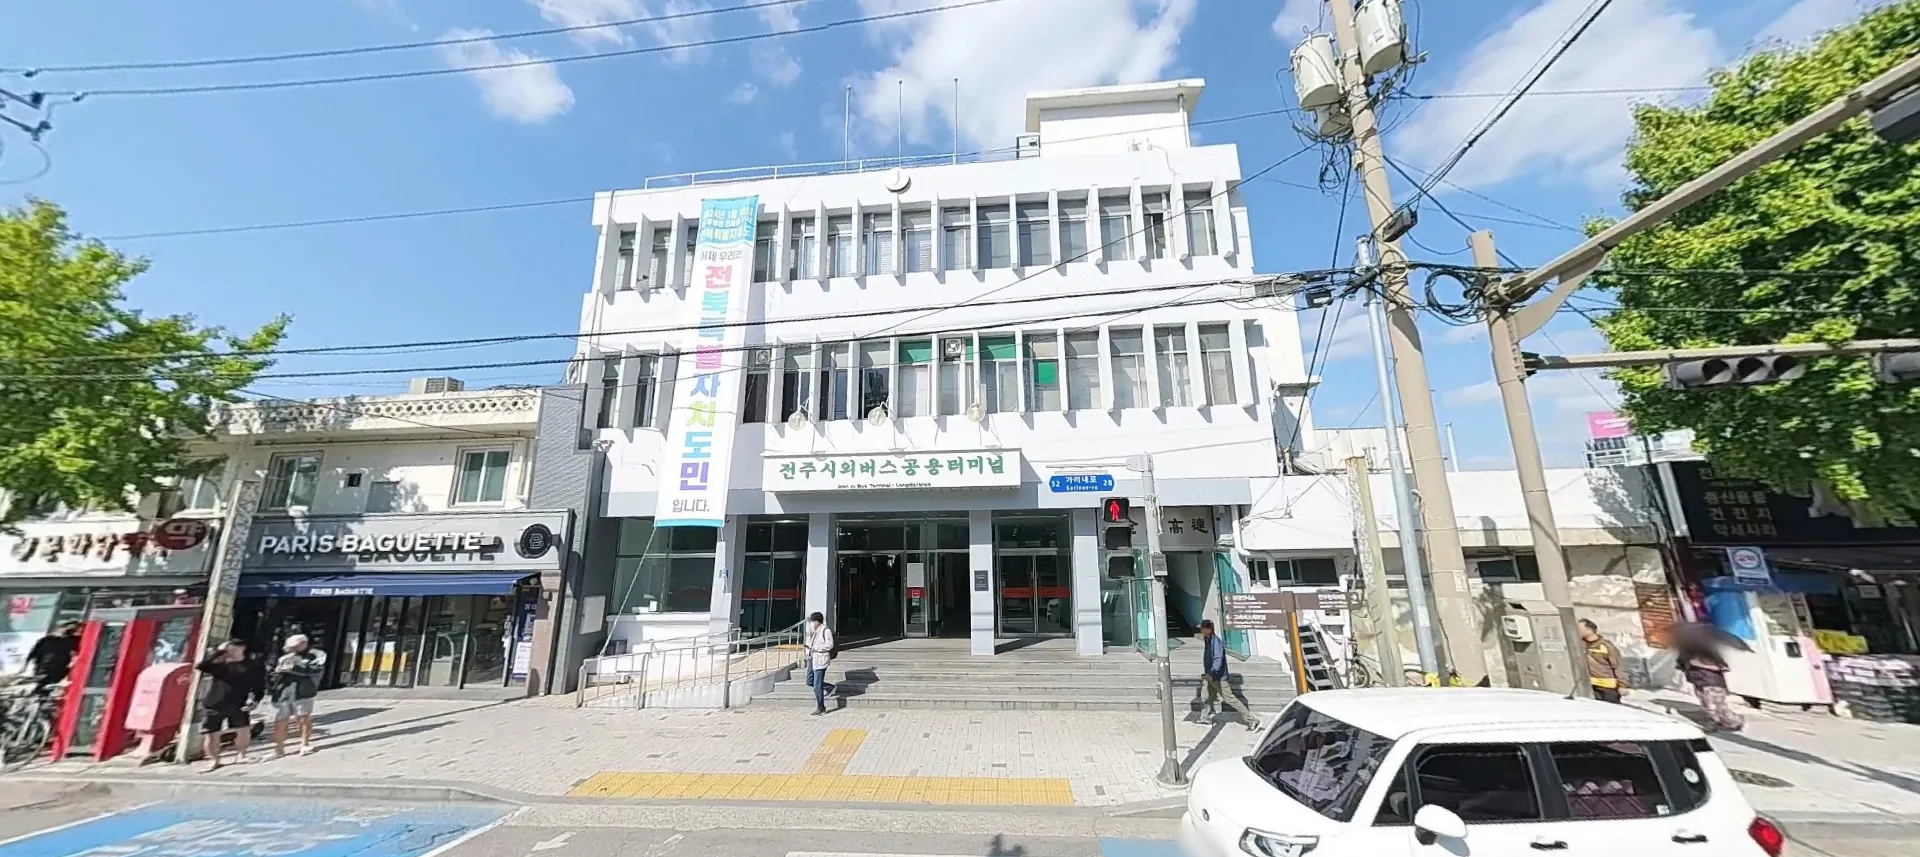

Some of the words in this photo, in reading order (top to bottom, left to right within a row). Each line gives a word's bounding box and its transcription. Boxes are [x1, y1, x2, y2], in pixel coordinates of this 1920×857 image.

[700, 250, 717, 262] 이제
[719, 250, 743, 263] 우리는
[779, 455, 1005, 480] 전주시외버스공용터미널
[1051, 480, 1061, 488] 32
[1103, 479, 1113, 487] 28
[672, 498, 710, 513] 입니다.
[166, 522, 202, 546] 약
[258, 534, 335, 554] PARIS
[340, 531, 483, 553] BAGUETTE
[310, 588, 333, 597] PARIS
